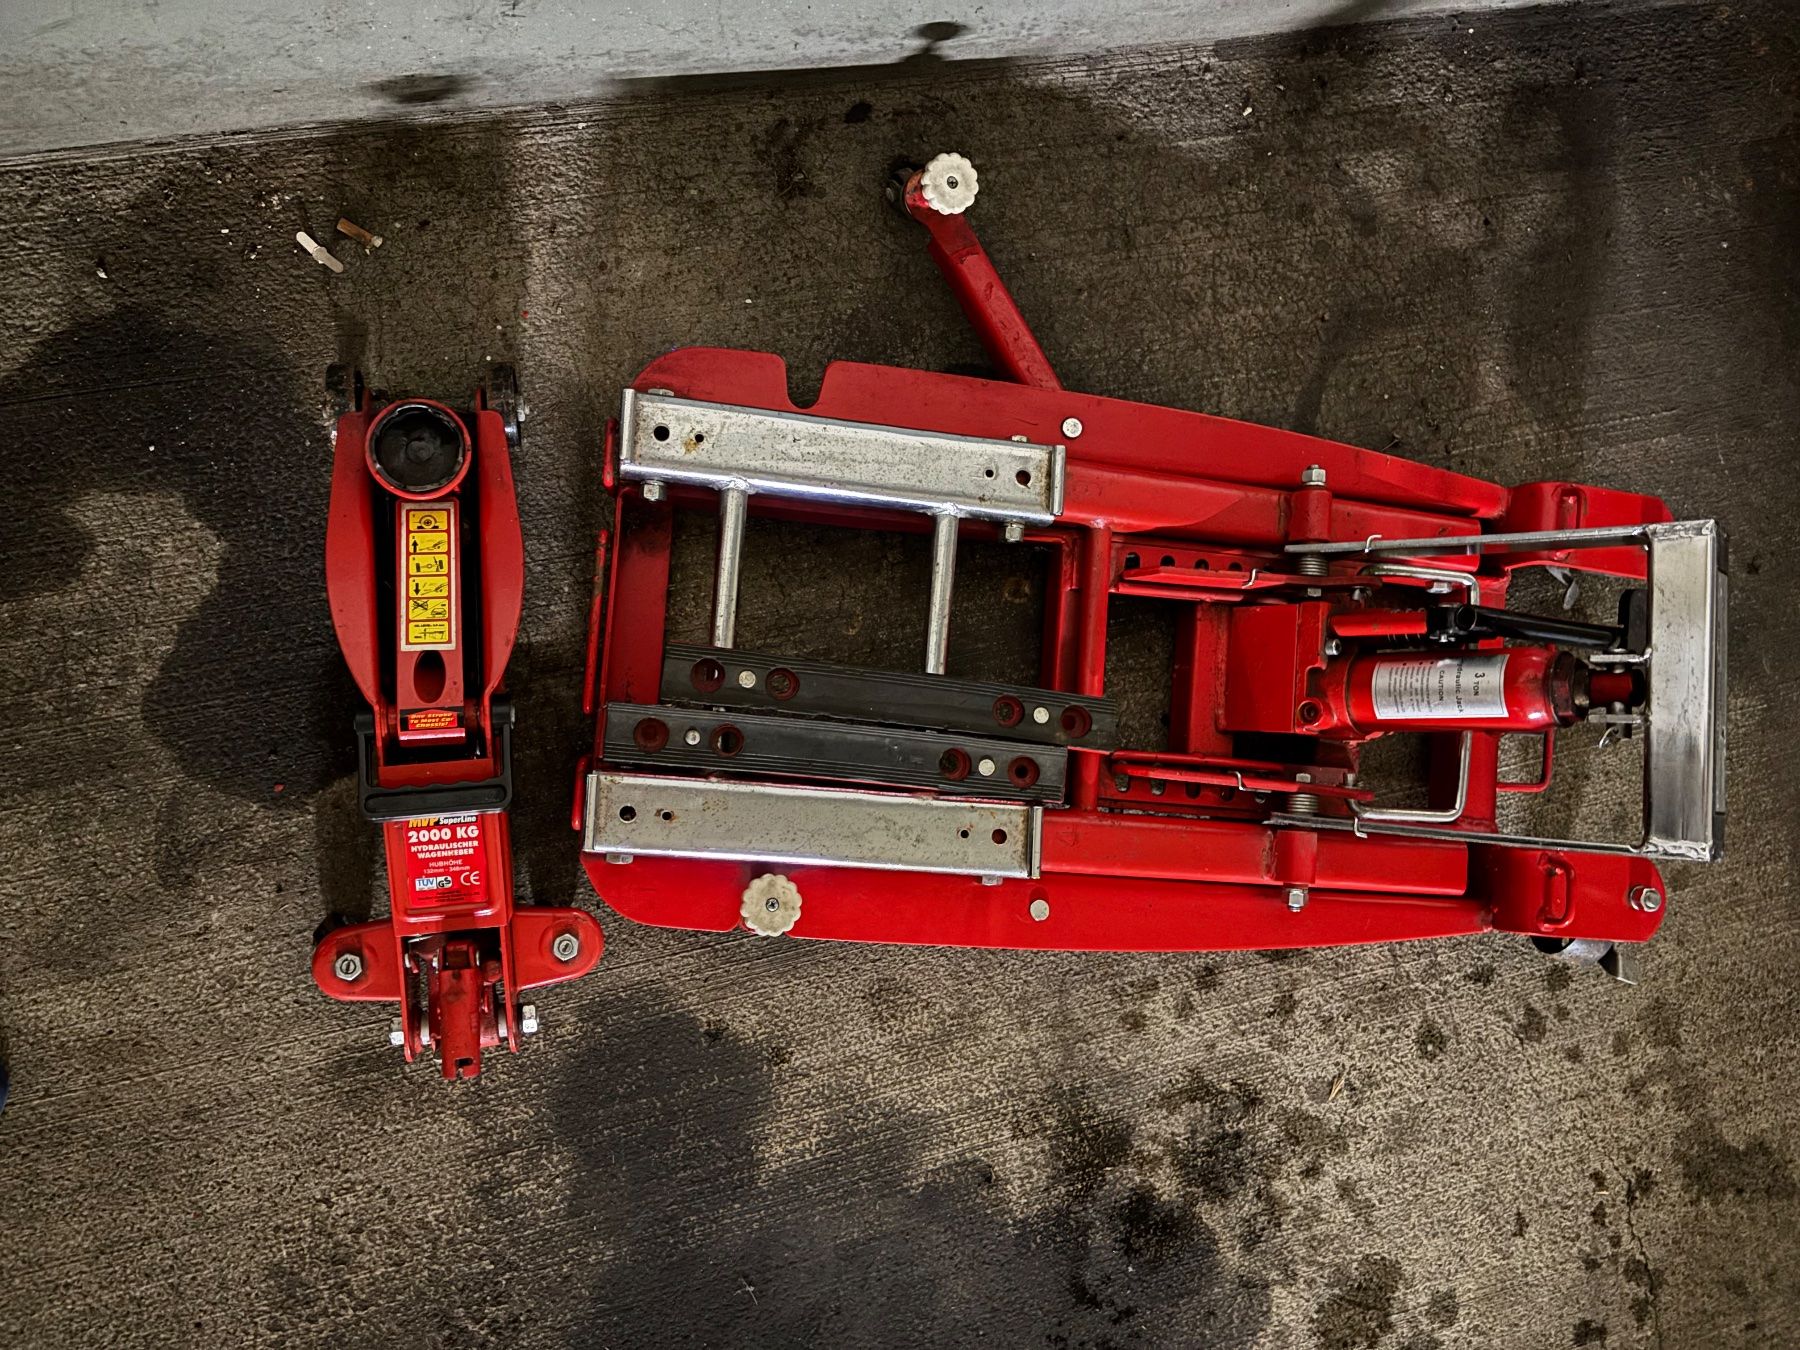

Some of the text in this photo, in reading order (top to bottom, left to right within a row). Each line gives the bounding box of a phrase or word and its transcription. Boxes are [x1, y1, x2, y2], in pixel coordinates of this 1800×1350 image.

[1456, 696, 1464, 713] Jack
[439, 816, 476, 825] SuperLine
[407, 825, 479, 843] 2000 KG
[410, 840, 479, 853] HYDRAULISCHER
[417, 848, 474, 859] WAGENHEBER
[416, 875, 435, 887] TÜV
[437, 877, 451, 888] GS
[460, 871, 480, 886] CE
